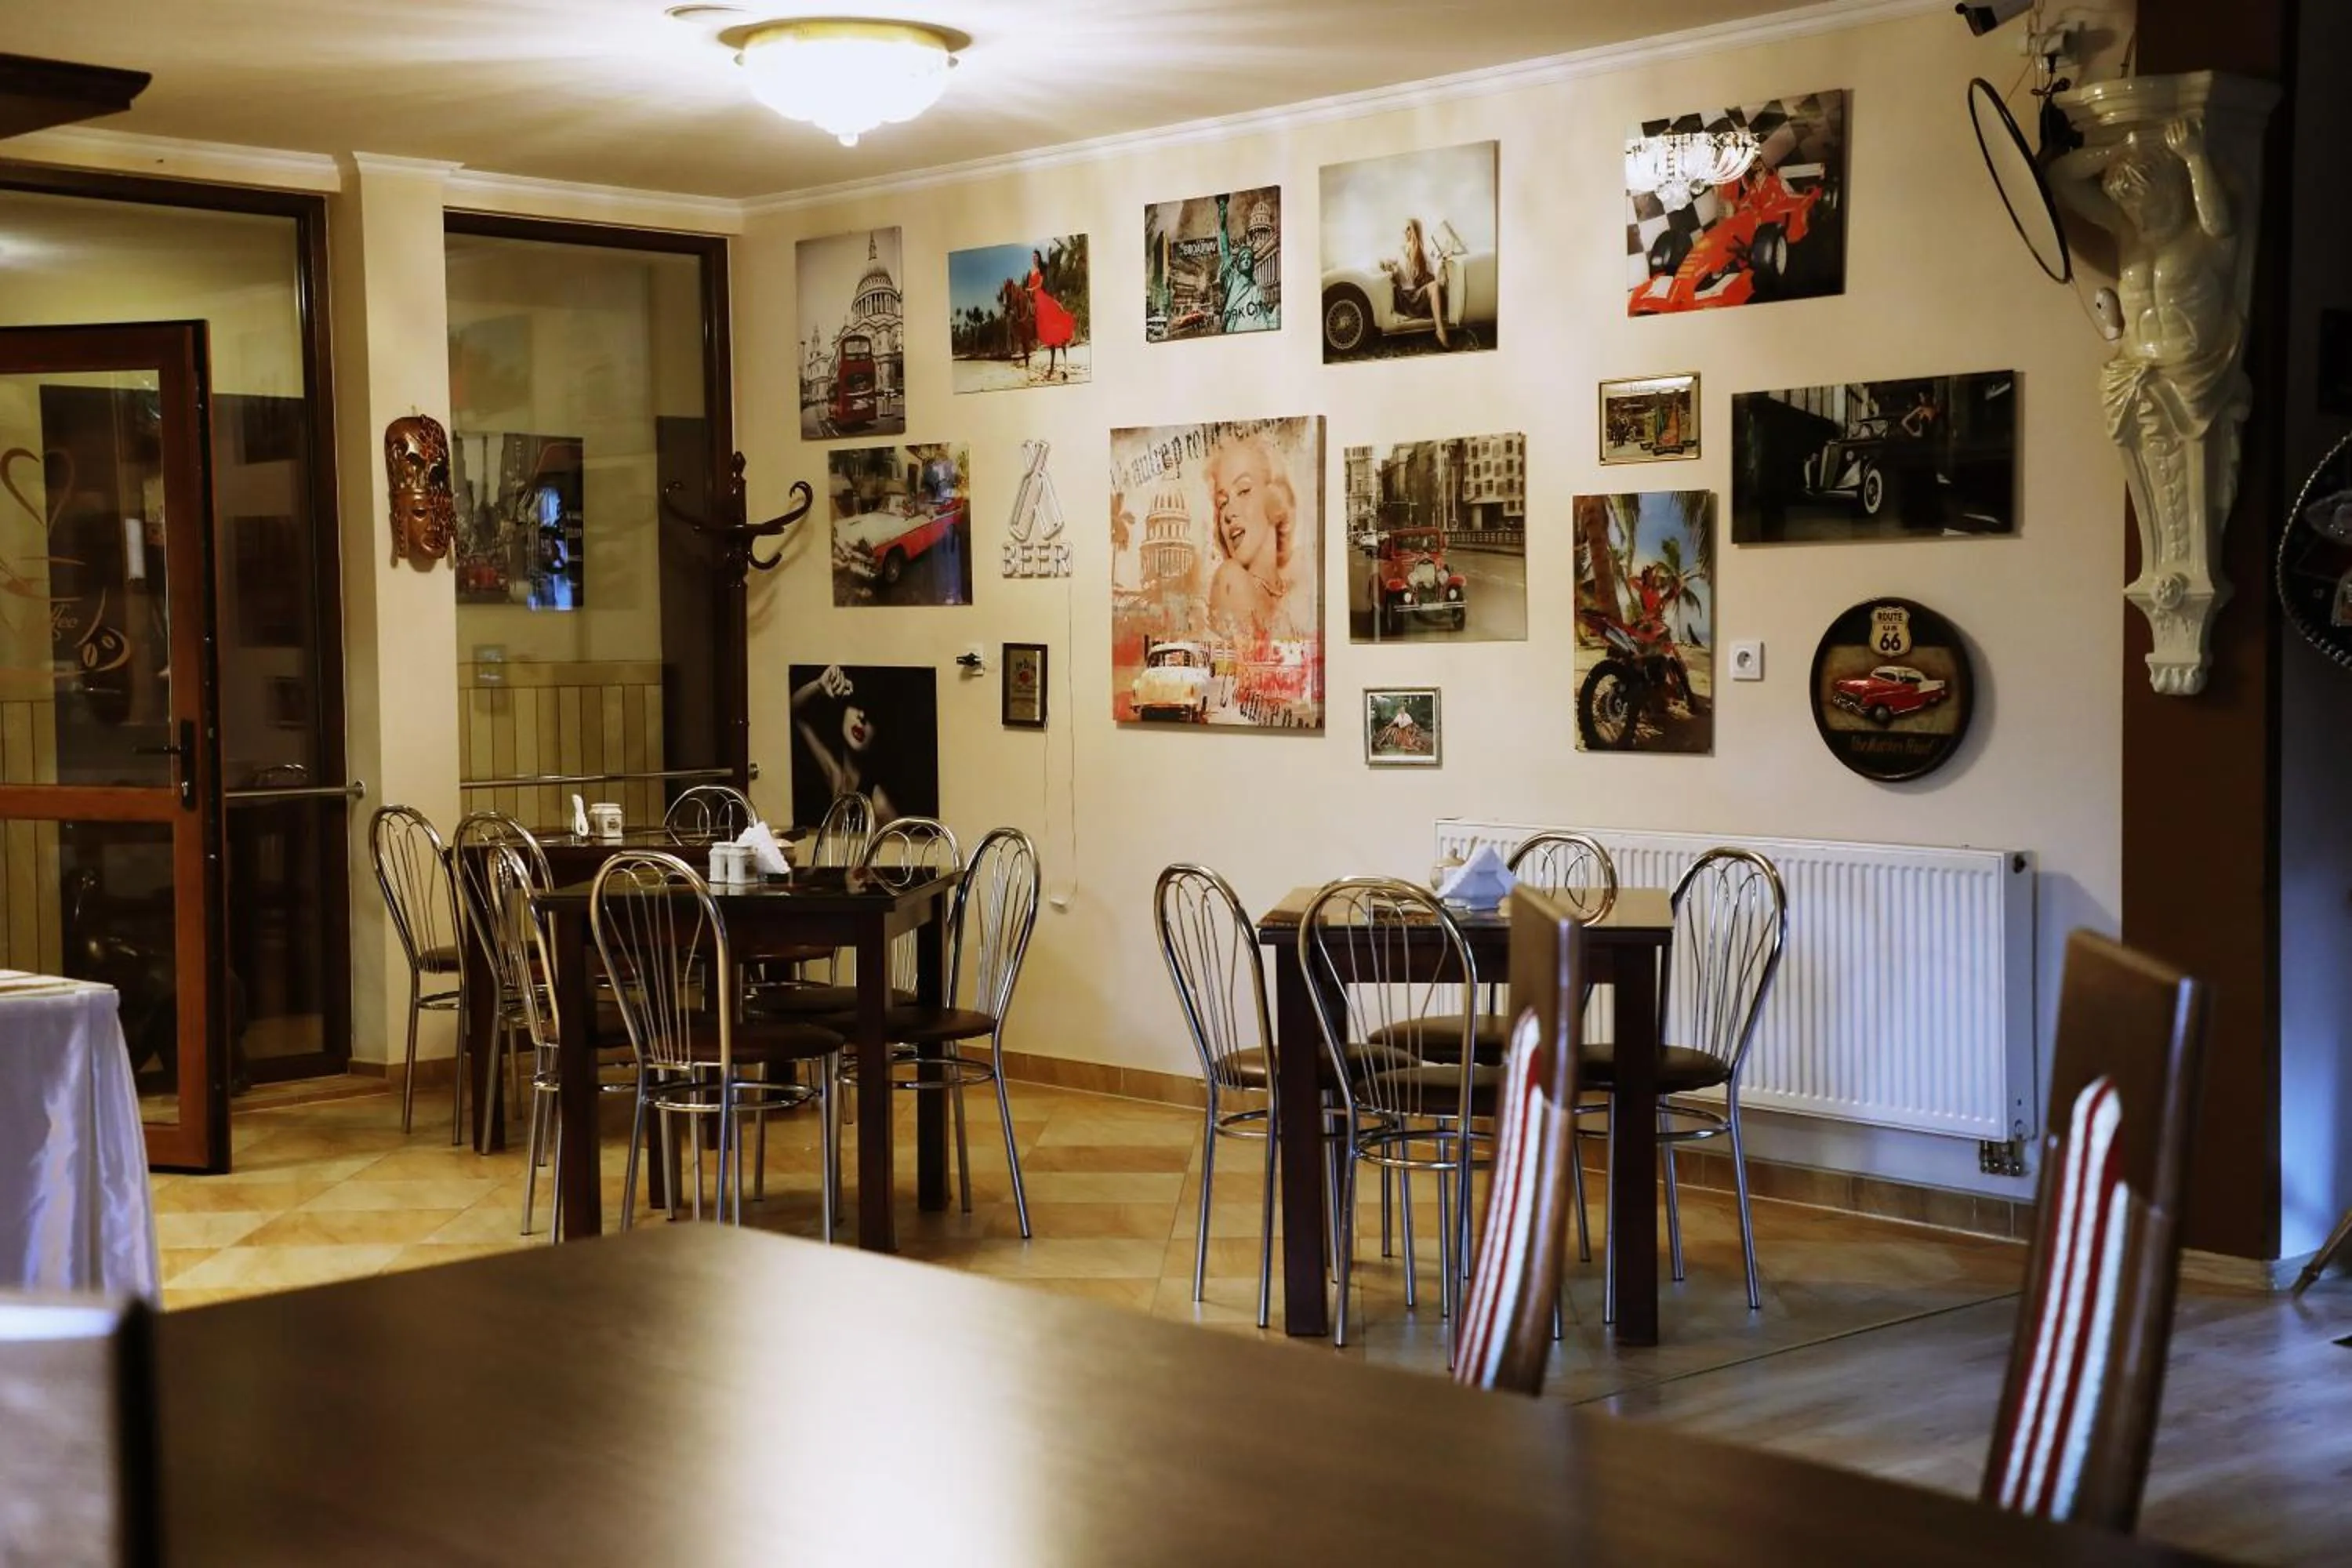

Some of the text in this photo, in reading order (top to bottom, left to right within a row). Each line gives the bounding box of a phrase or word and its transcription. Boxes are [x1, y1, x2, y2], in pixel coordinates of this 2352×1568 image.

[1002, 542, 1073, 578] BEER
[1877, 612, 1904, 622] ROUTE
[1879, 633, 1901, 652] 66
